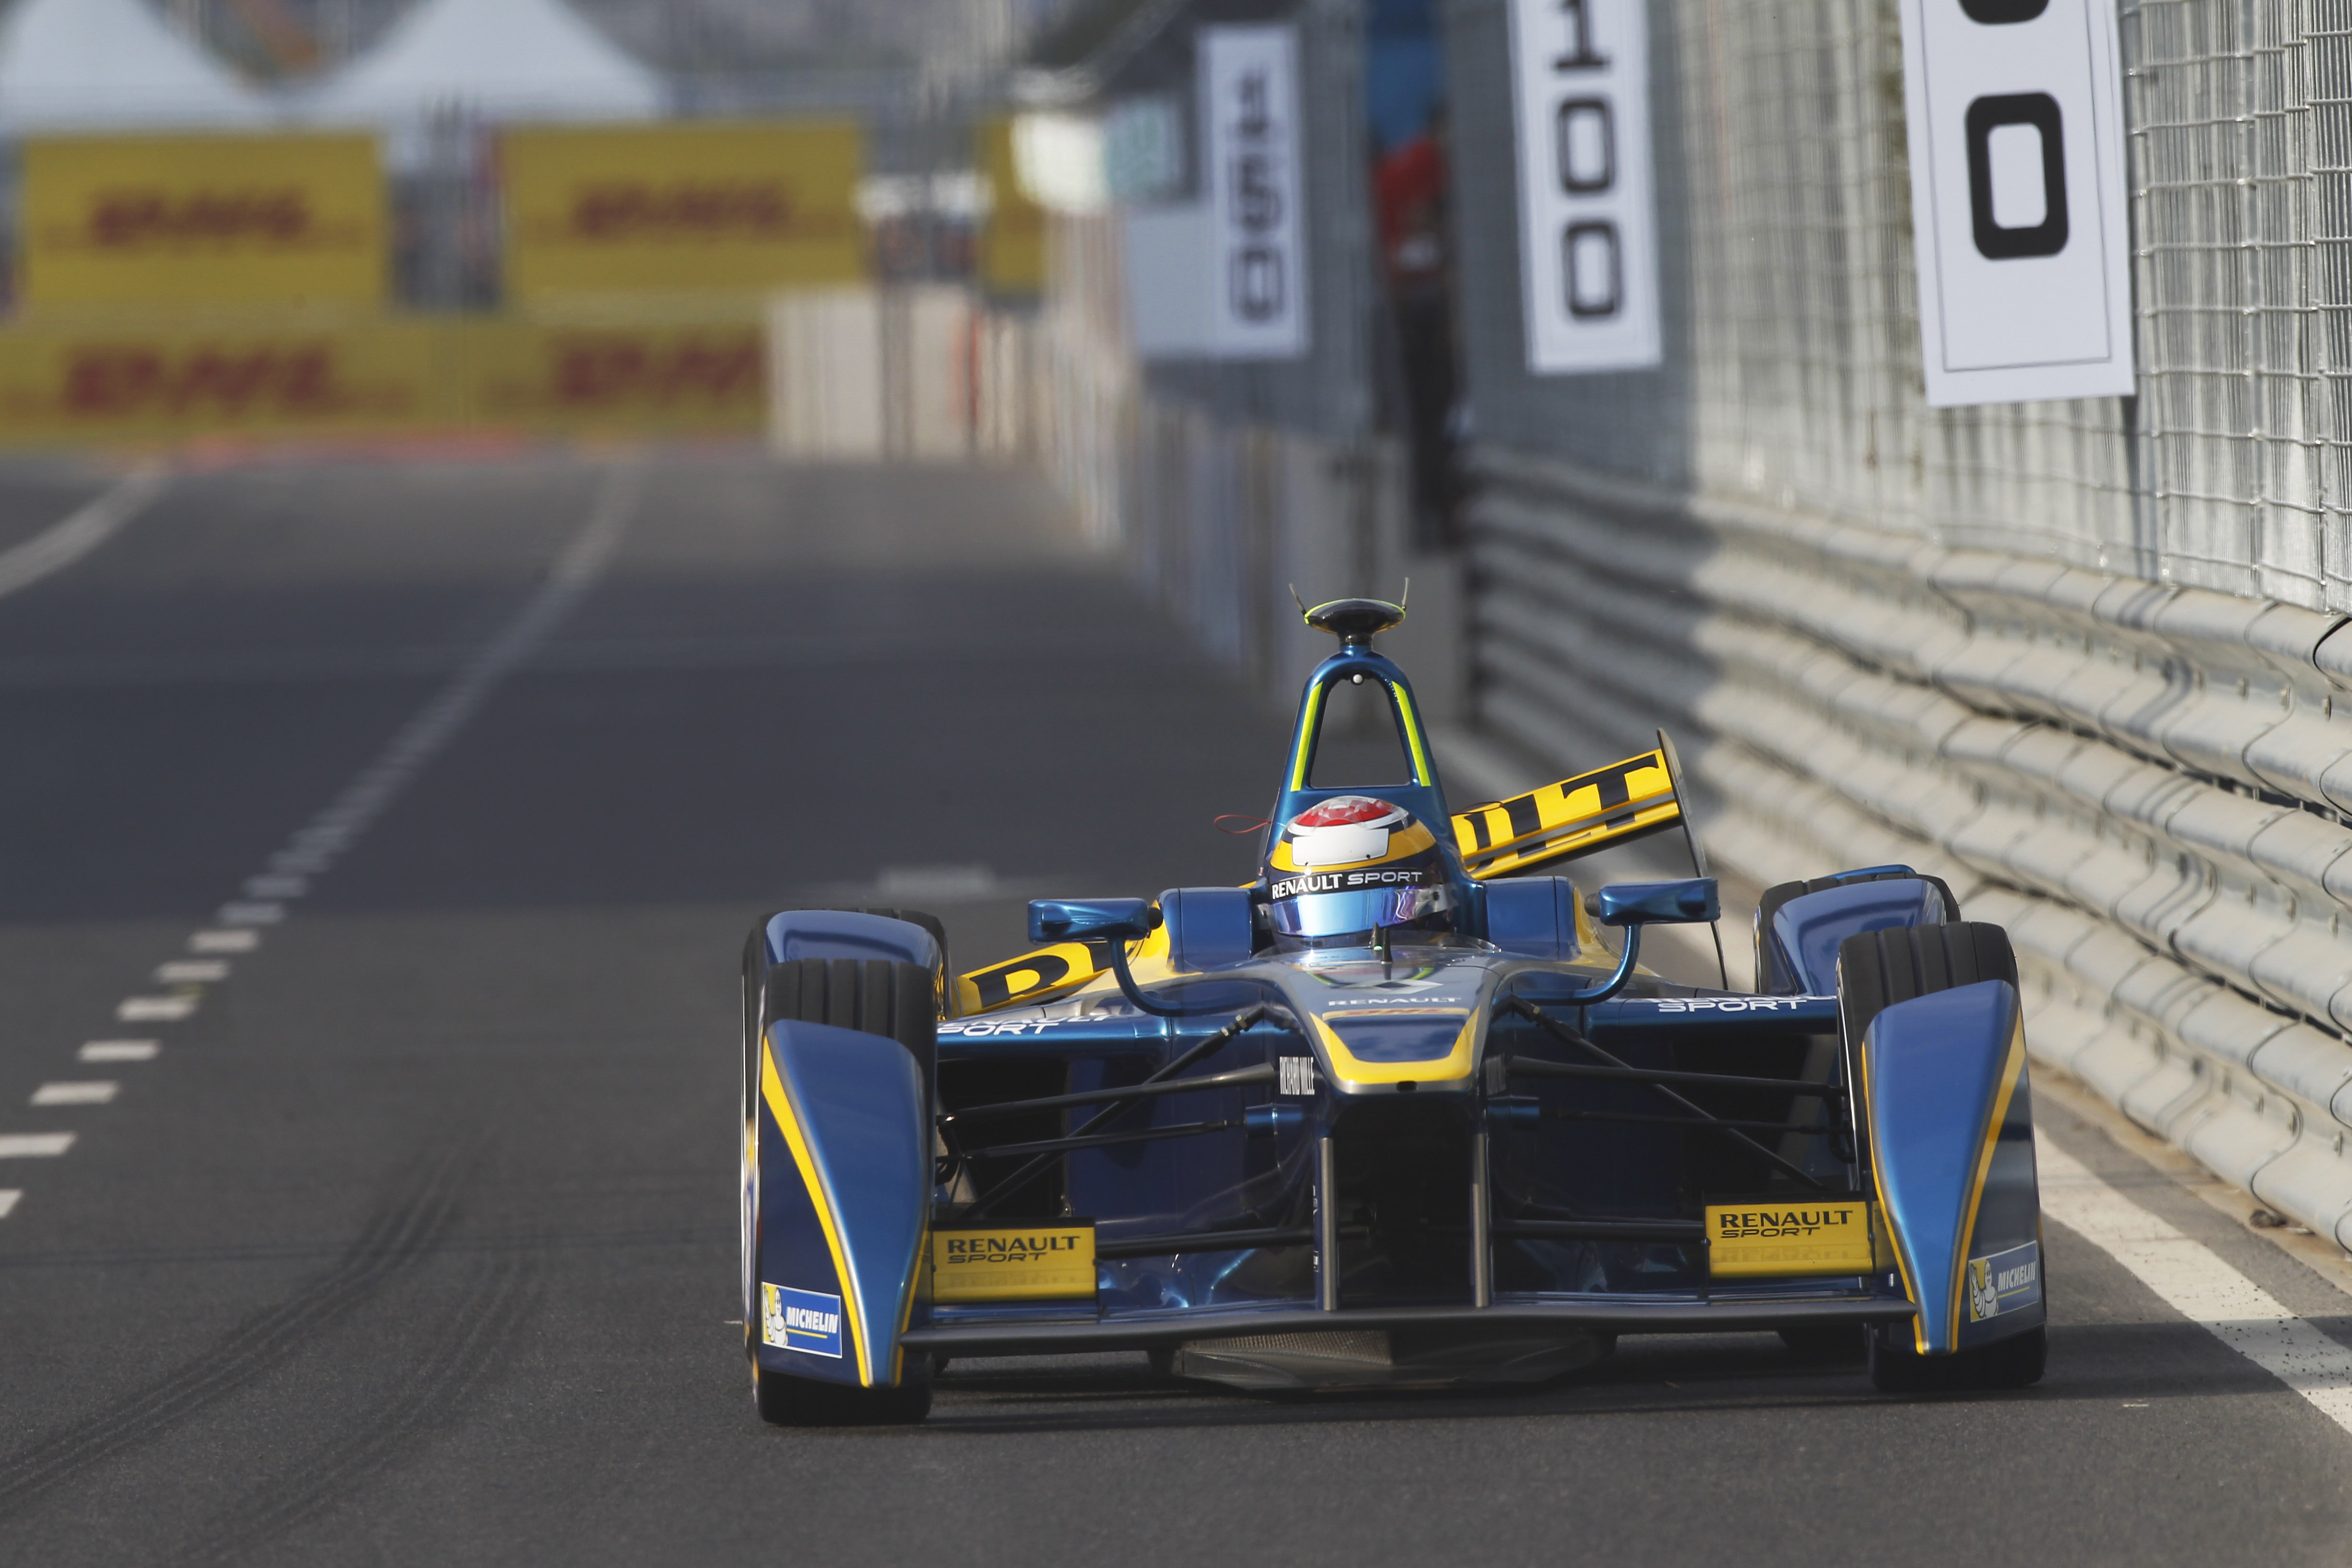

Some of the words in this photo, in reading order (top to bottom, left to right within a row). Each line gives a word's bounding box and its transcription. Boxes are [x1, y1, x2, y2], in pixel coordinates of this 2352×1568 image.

[1954, 0, 2069, 261] 0
[1551, 0, 1624, 321] 100
[1226, 66, 1285, 326] 150
[1272, 874, 1343, 900] RENAULT
[1347, 872, 1422, 885] SPORT
[1328, 997, 1461, 1006] RENAULT
[1658, 999, 1807, 1013] SPORT
[937, 1022, 1059, 1036] PORT
[1719, 1210, 1853, 1228] RENAULT
[1721, 1226, 1821, 1238] SPORT
[948, 1236, 1080, 1253] RENAULT
[948, 1252, 1048, 1264] SPORT
[1997, 1261, 2036, 1292] MICHELIN
[786, 1306, 838, 1334] MICHELIN
